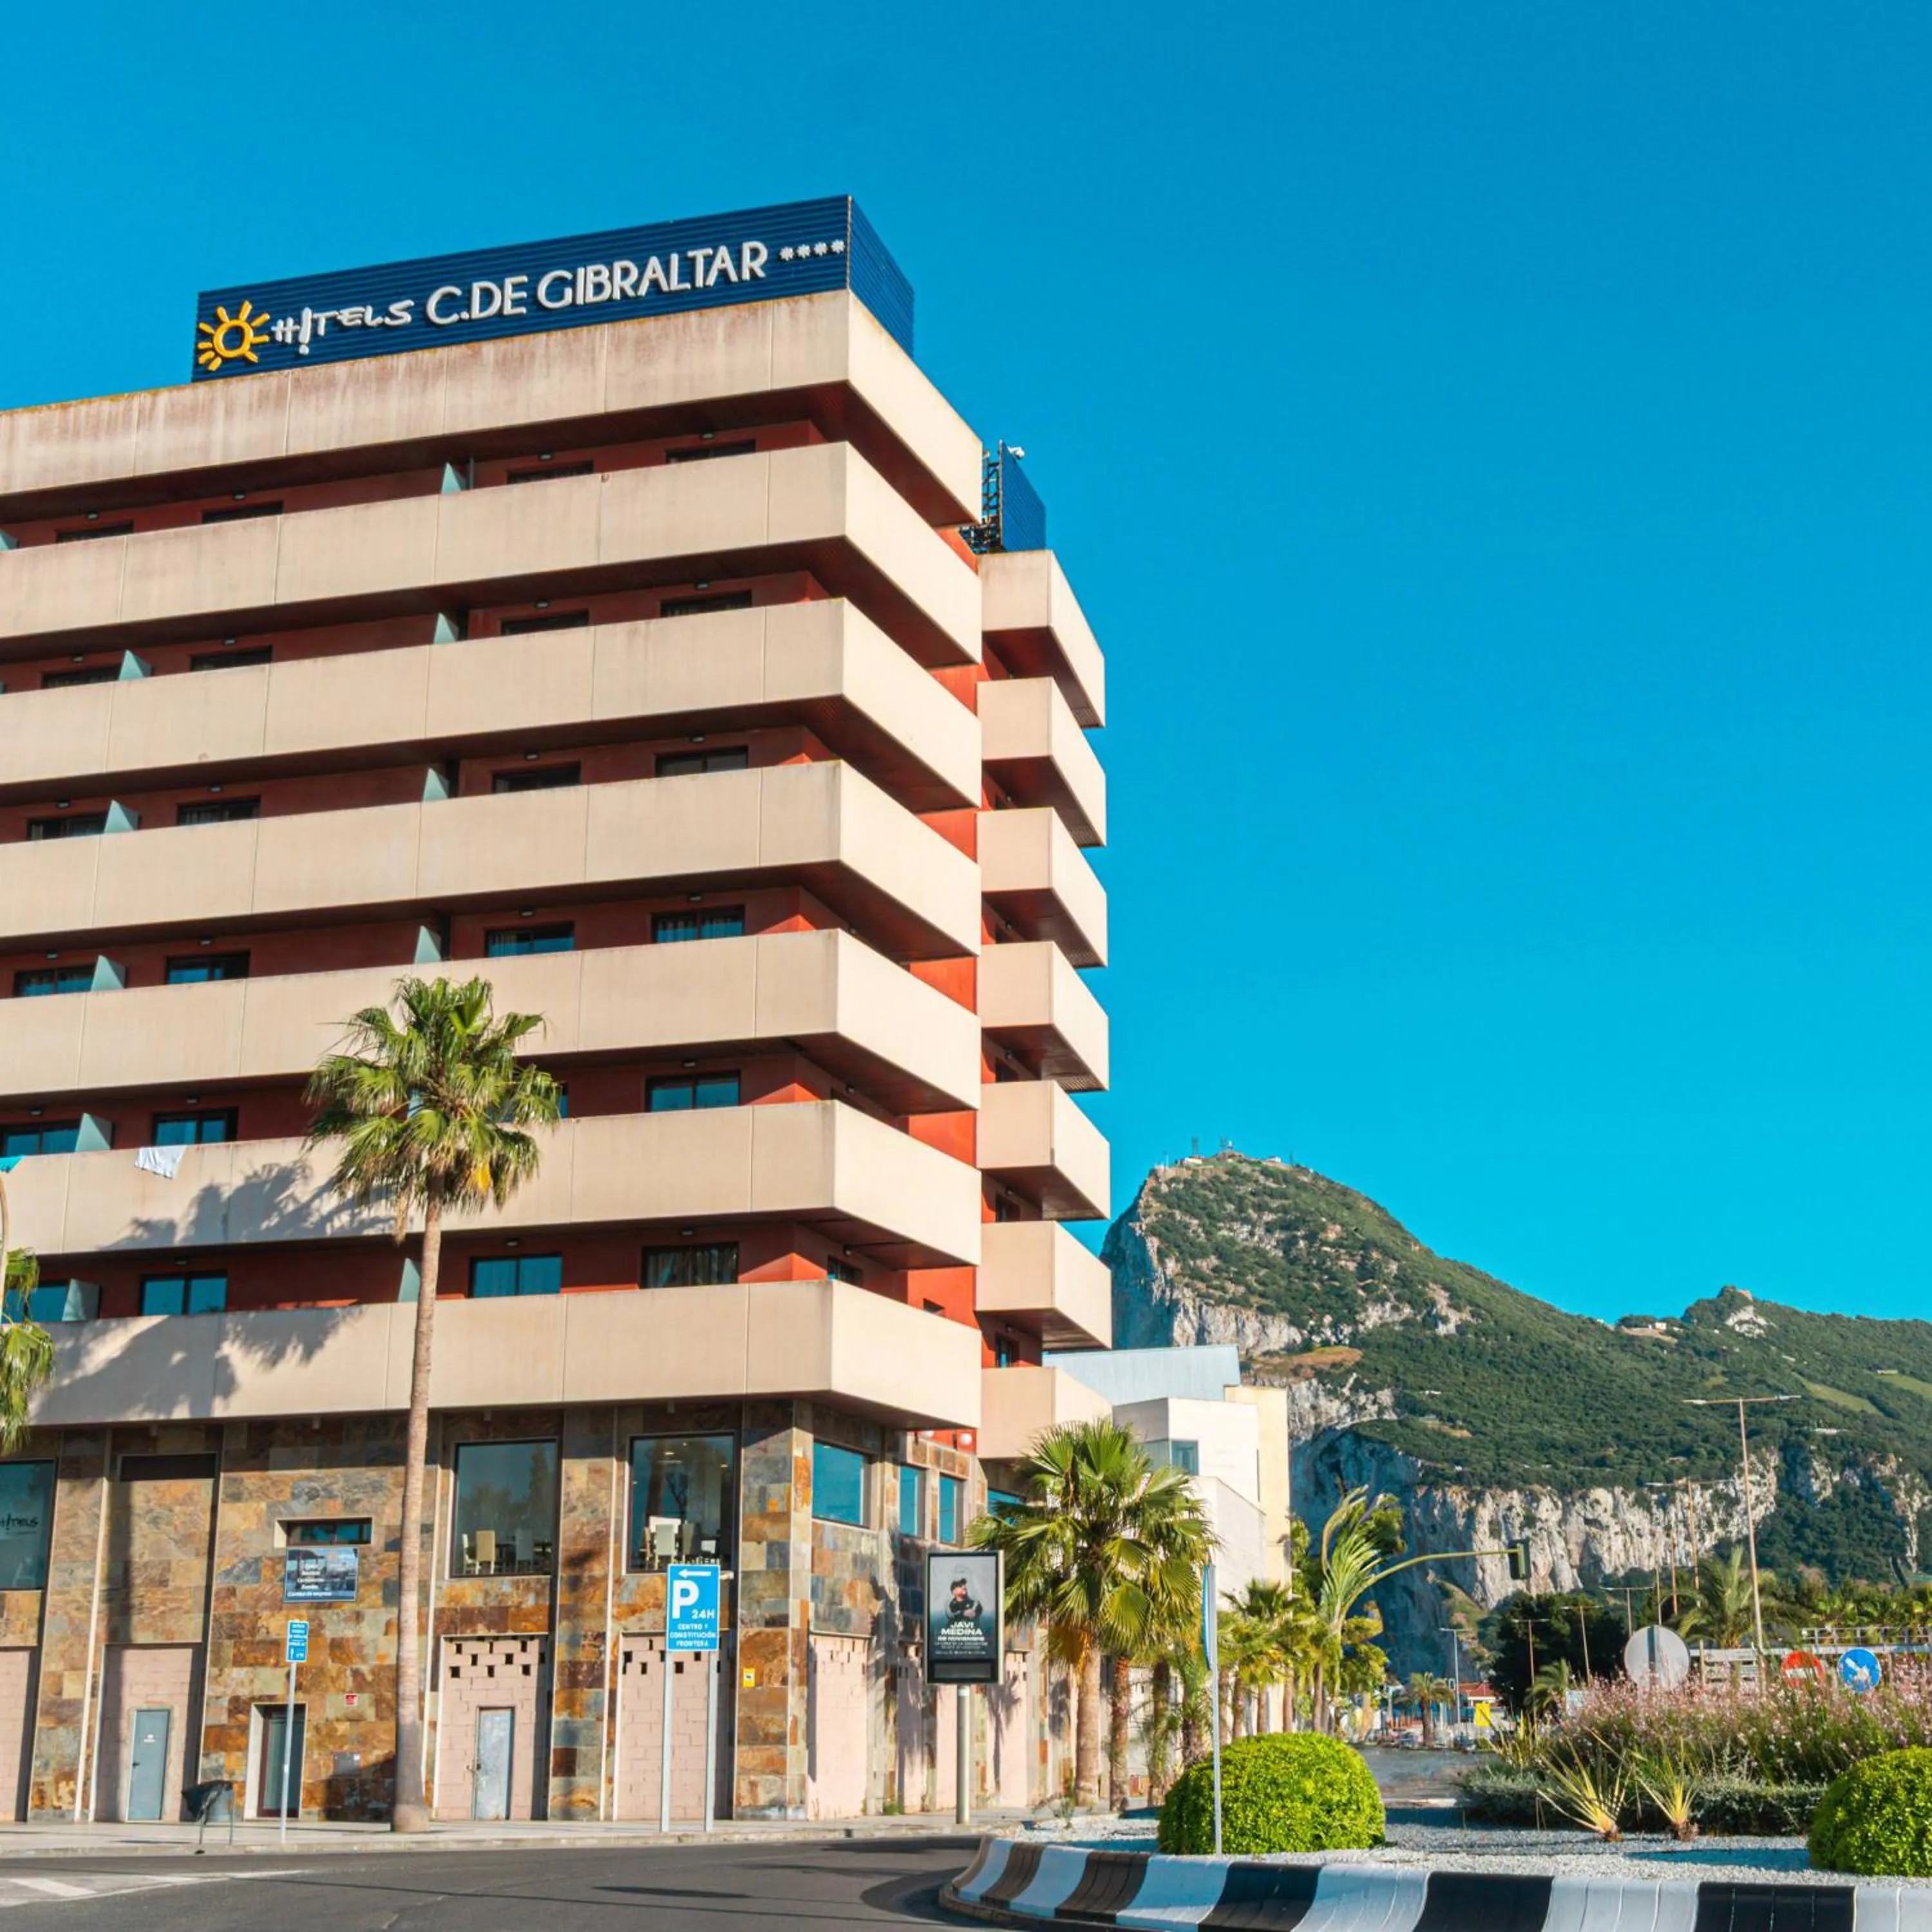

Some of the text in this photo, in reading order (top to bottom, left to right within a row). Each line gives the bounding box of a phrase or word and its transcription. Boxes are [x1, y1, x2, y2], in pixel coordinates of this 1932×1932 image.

[536, 241, 768, 309] GIBRALTAR
[672, 1580, 699, 1619] P
[691, 1608, 715, 1619] 24H
